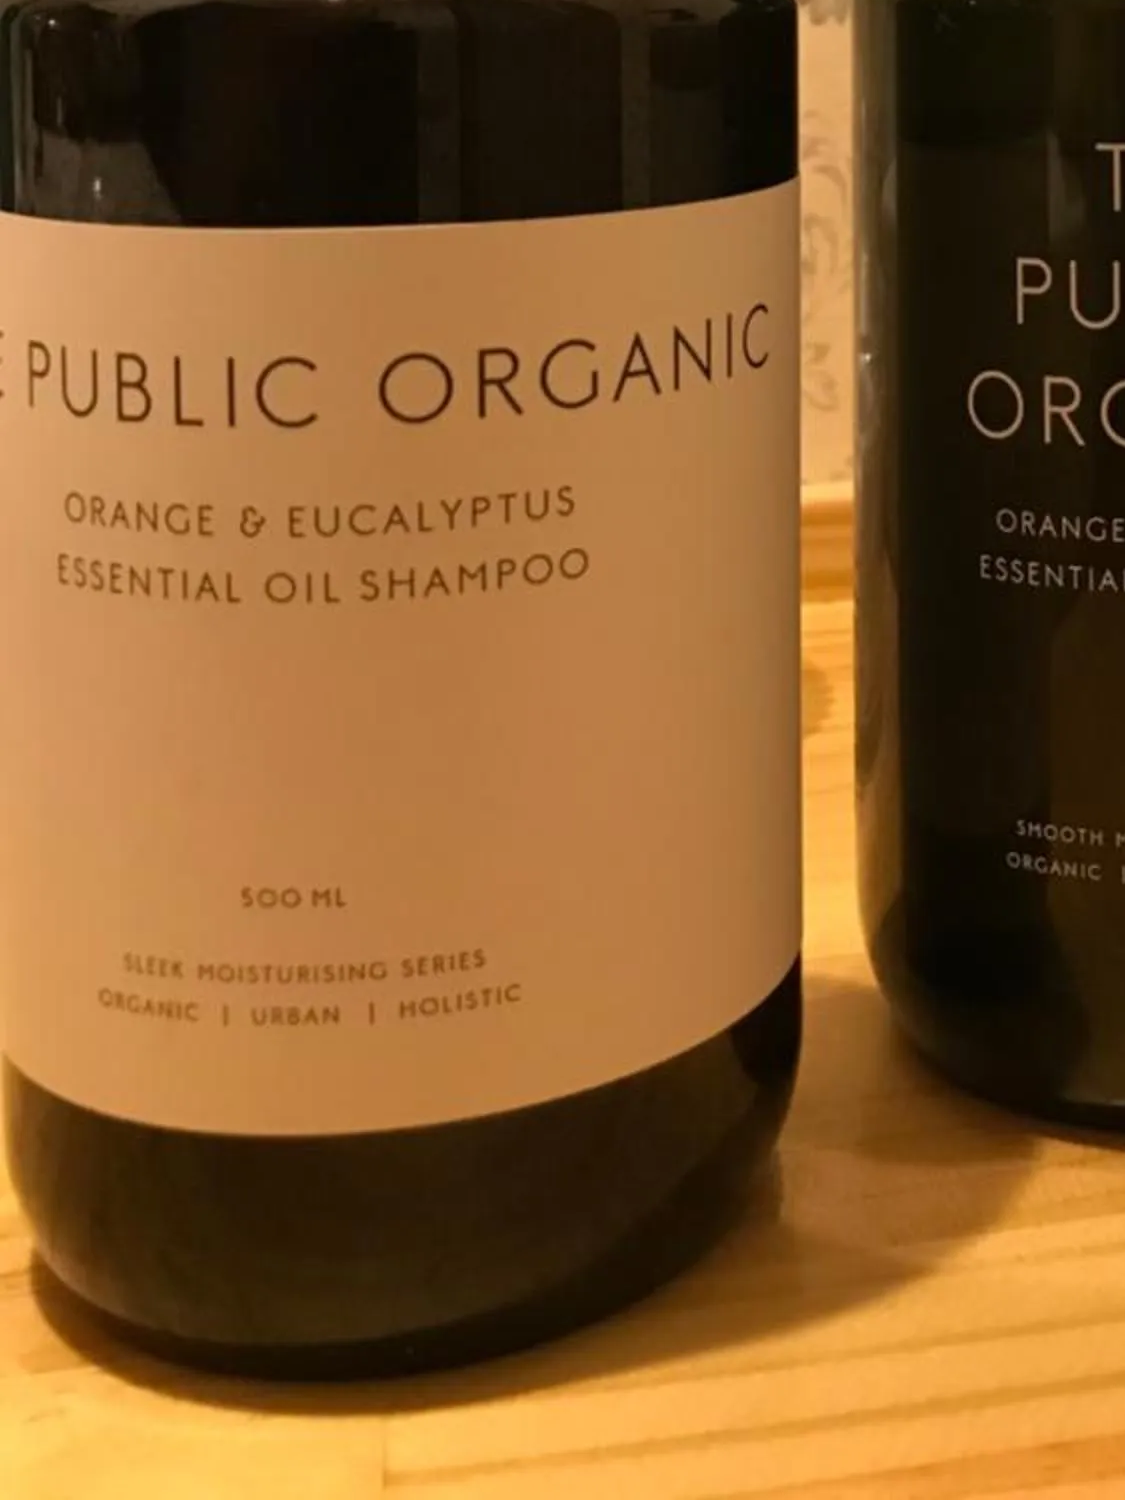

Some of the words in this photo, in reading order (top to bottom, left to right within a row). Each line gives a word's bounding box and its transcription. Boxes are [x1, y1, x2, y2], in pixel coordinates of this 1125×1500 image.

[28, 340, 318, 427] PUBLIC
[378, 303, 769, 425] ORGANIC
[64, 490, 214, 537] ORANGE
[239, 504, 267, 538] &
[288, 485, 576, 539] EUCALYPTUS
[996, 508, 1125, 543] ORANGE
[57, 553, 242, 603] ESSENTIAL
[264, 571, 341, 604] OIL
[359, 547, 590, 602] SHAMPOO
[1016, 819, 1102, 847] SMOOTH
[1005, 851, 1101, 881] ORGANIC
[241, 887, 302, 910] 500
[312, 888, 347, 909] ML
[123, 952, 184, 979] SLEEK
[197, 961, 388, 986] MOISTURISING
[401, 948, 487, 979] SERIES
[97, 988, 200, 1023] ORGANIC
[251, 1005, 341, 1027] URBAN
[399, 983, 522, 1020] HOLISTIC
